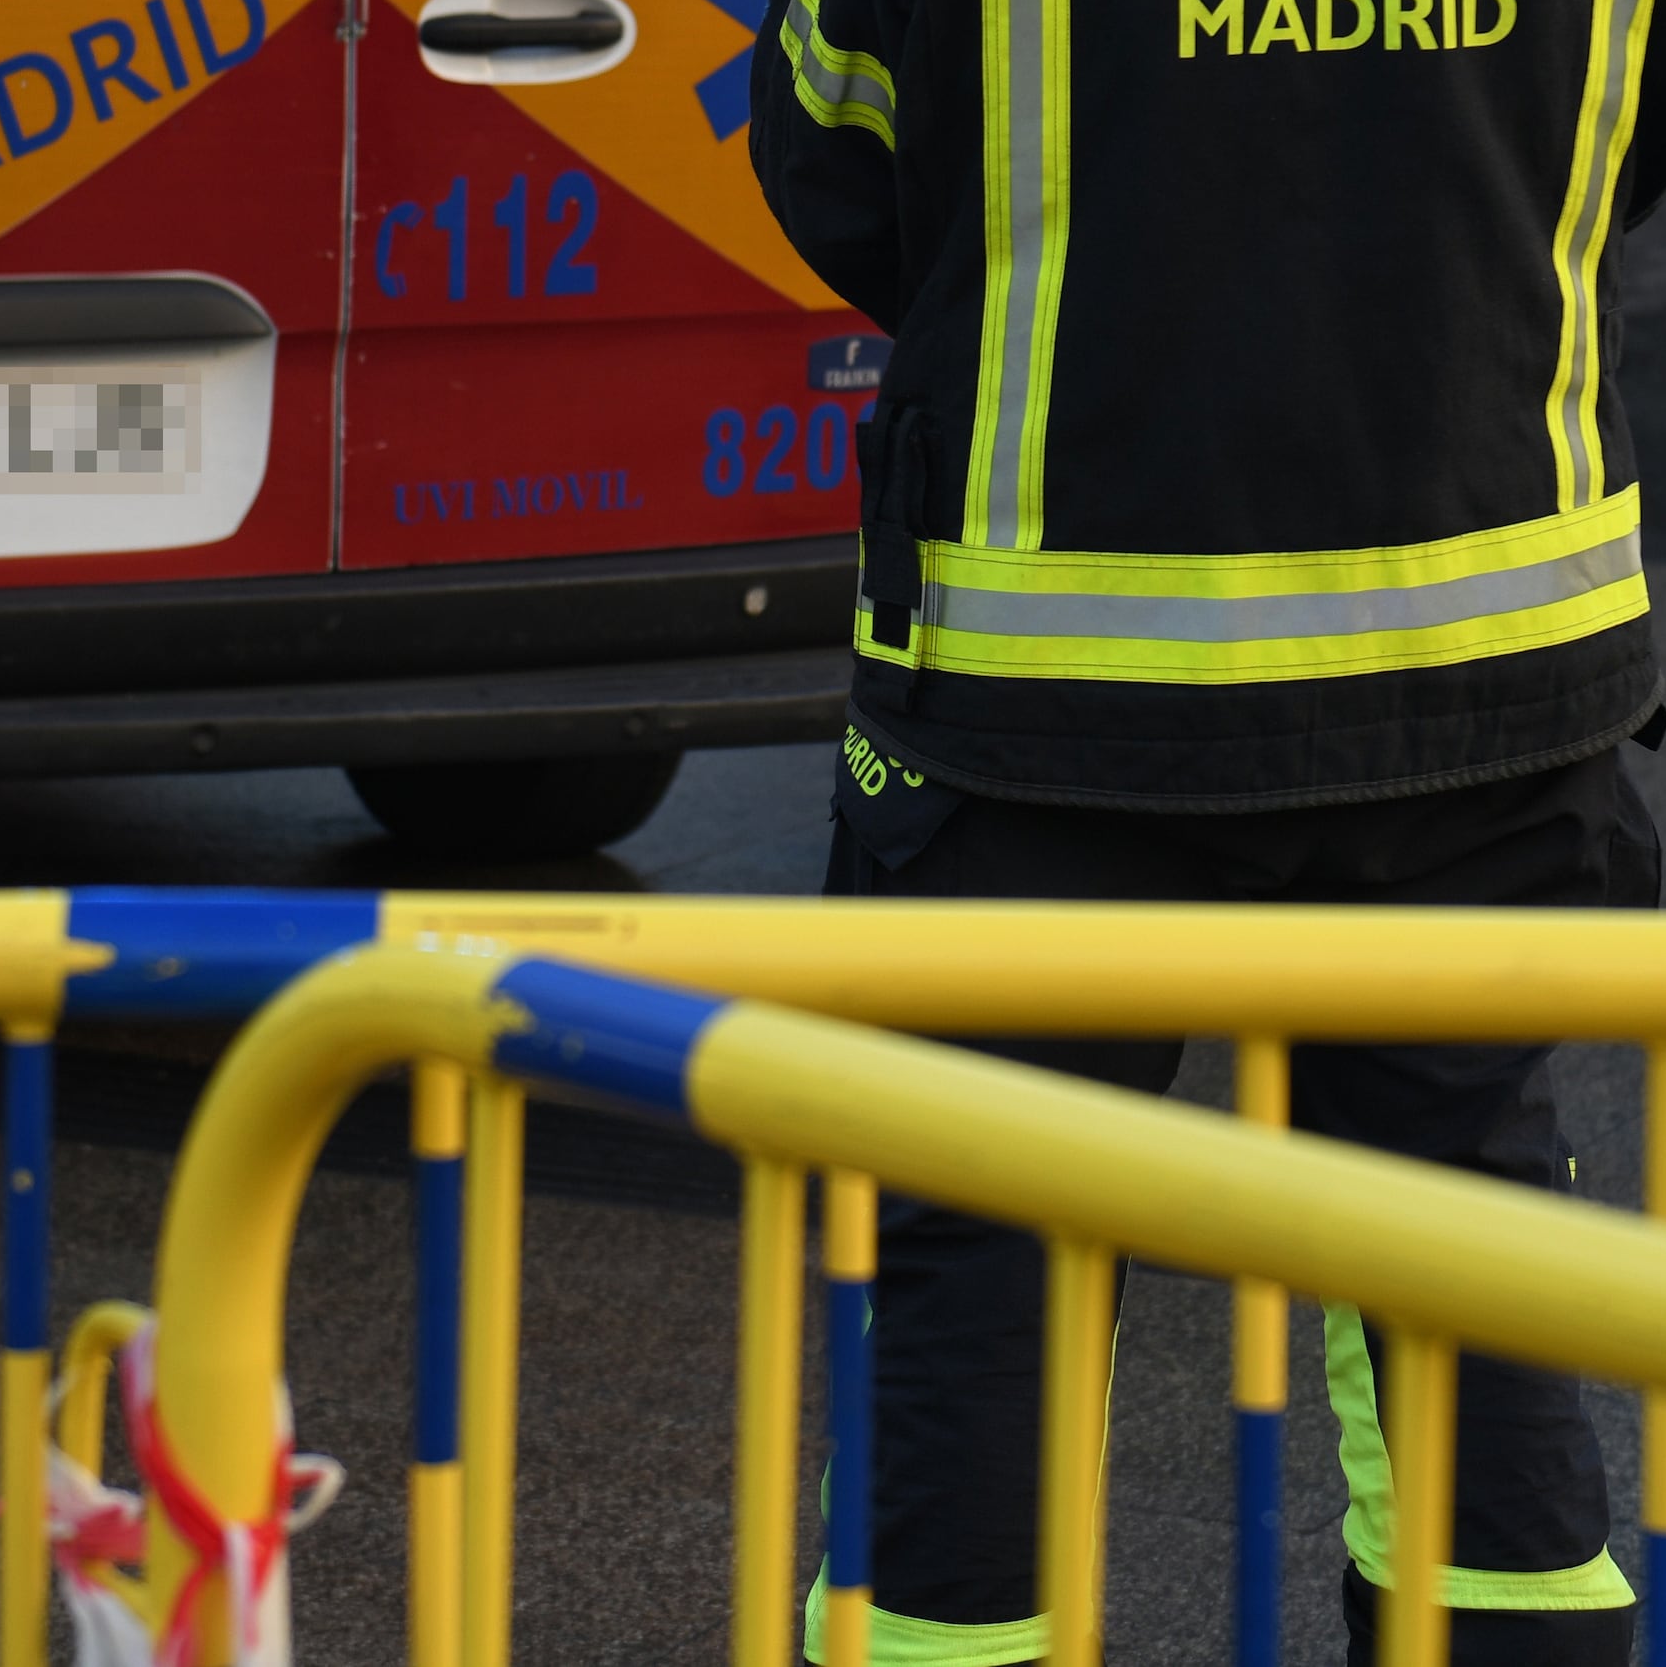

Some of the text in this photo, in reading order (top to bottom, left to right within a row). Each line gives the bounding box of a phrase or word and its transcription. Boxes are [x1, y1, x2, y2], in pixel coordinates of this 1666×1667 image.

[434, 169, 599, 302] 112
[393, 468, 645, 526] UVI MOVIL
[701, 398, 878, 498] 820
